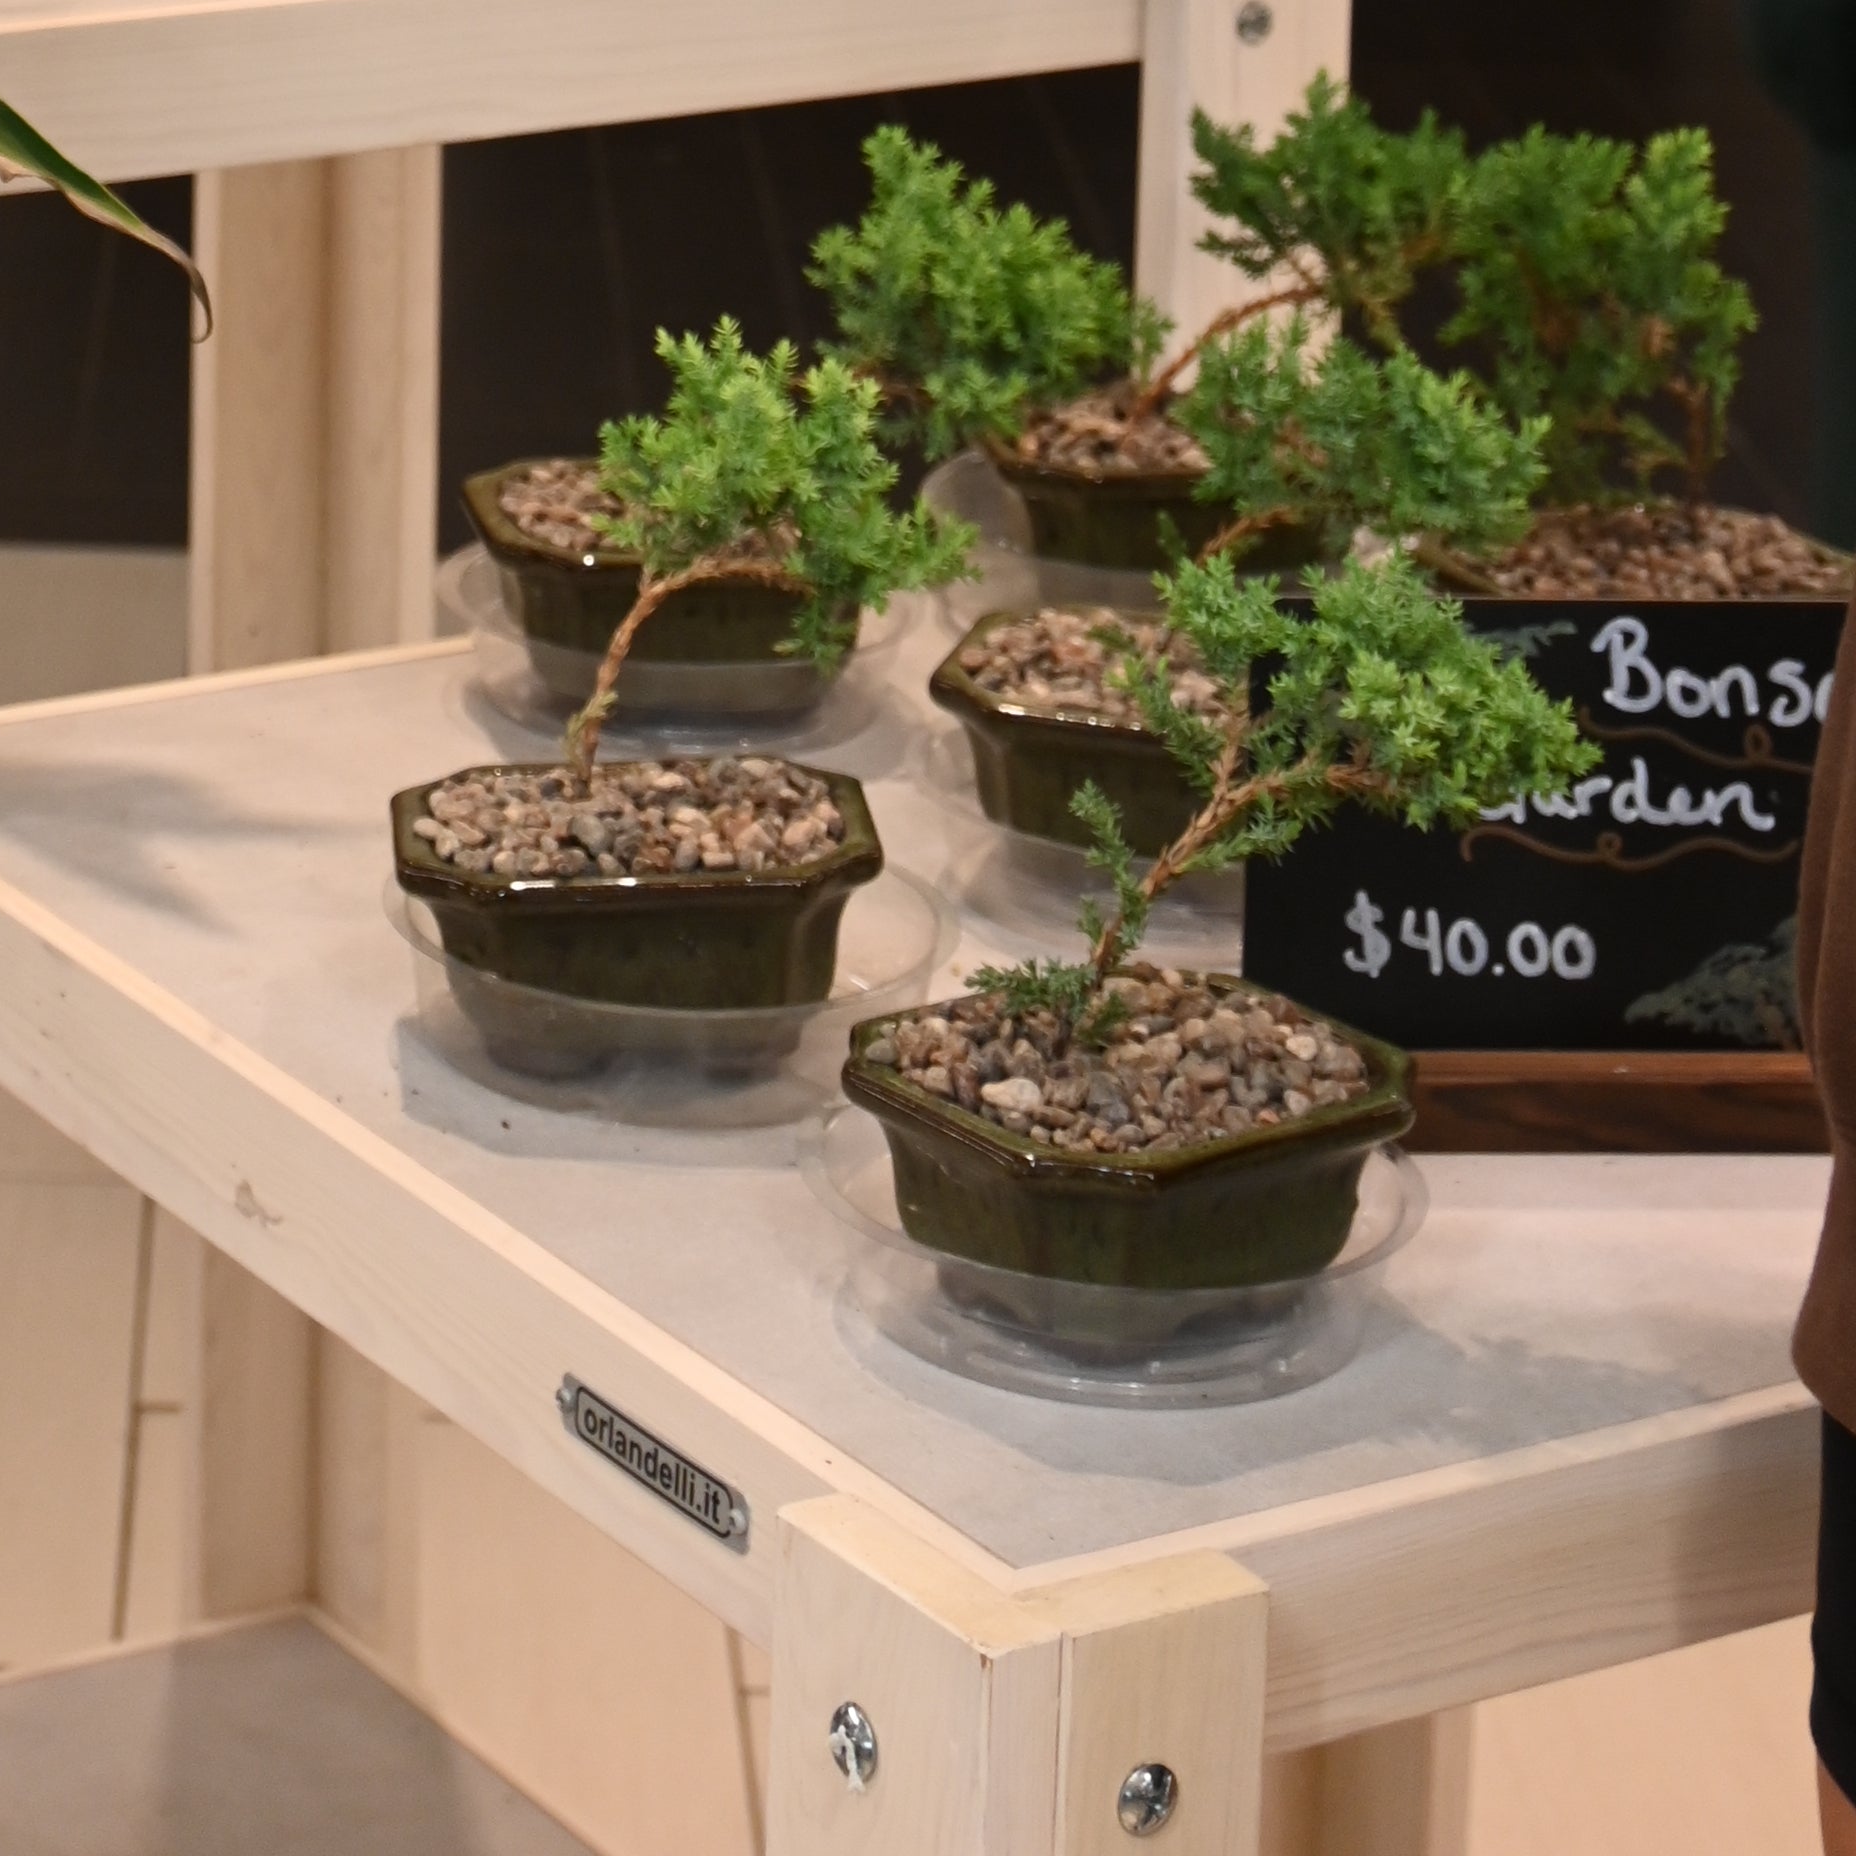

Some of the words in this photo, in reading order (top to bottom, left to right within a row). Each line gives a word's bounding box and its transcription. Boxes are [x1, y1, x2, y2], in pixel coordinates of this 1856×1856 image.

[1478, 755, 1777, 832] arden
[1341, 888, 1597, 980] $40.00
[583, 1407, 722, 1525] orlandelli.it
